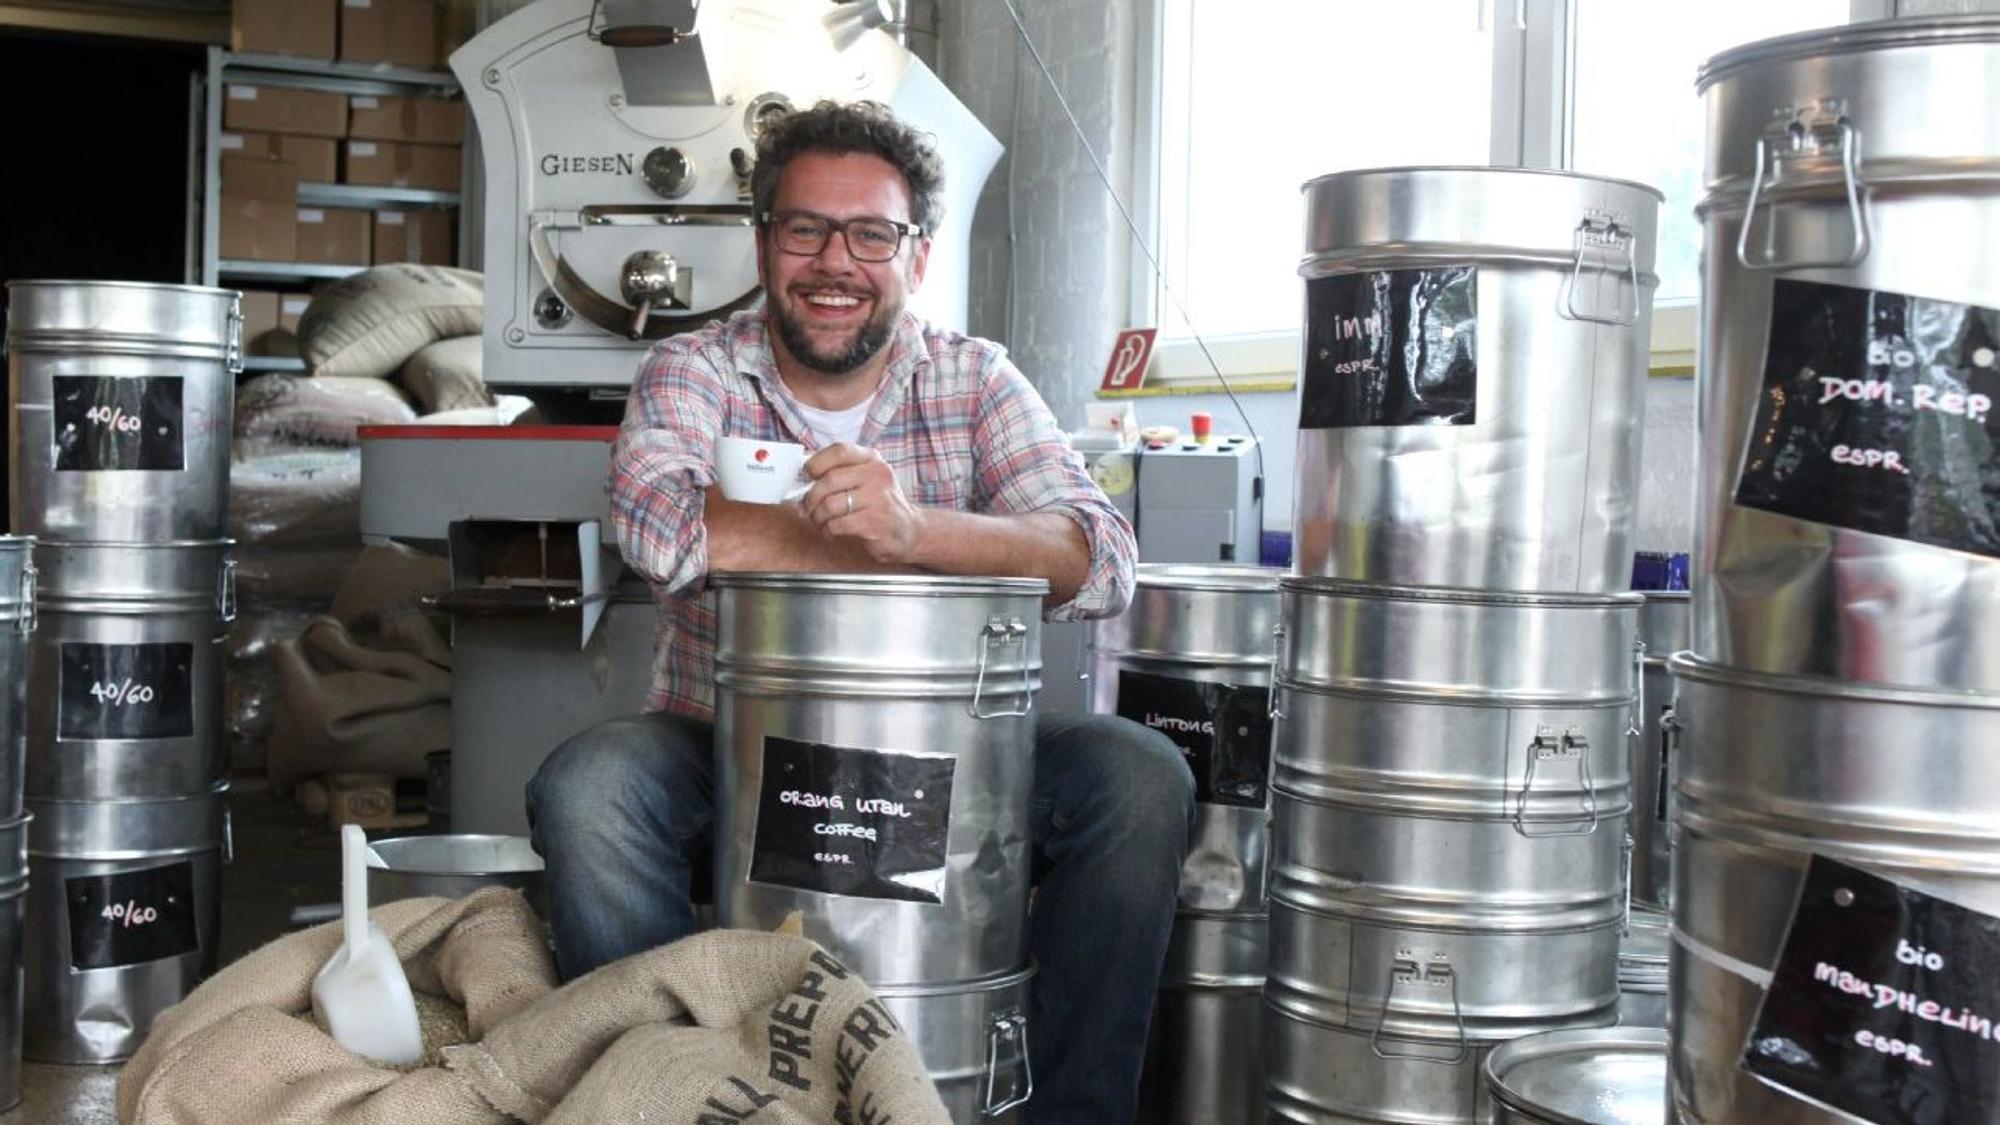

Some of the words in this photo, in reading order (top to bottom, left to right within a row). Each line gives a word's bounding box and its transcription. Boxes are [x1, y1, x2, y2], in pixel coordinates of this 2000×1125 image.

[86, 406, 141, 431] 40/60
[90, 678, 154, 706] 40/60
[101, 899, 157, 928] 40/60
[1896, 938, 1944, 971] bio
